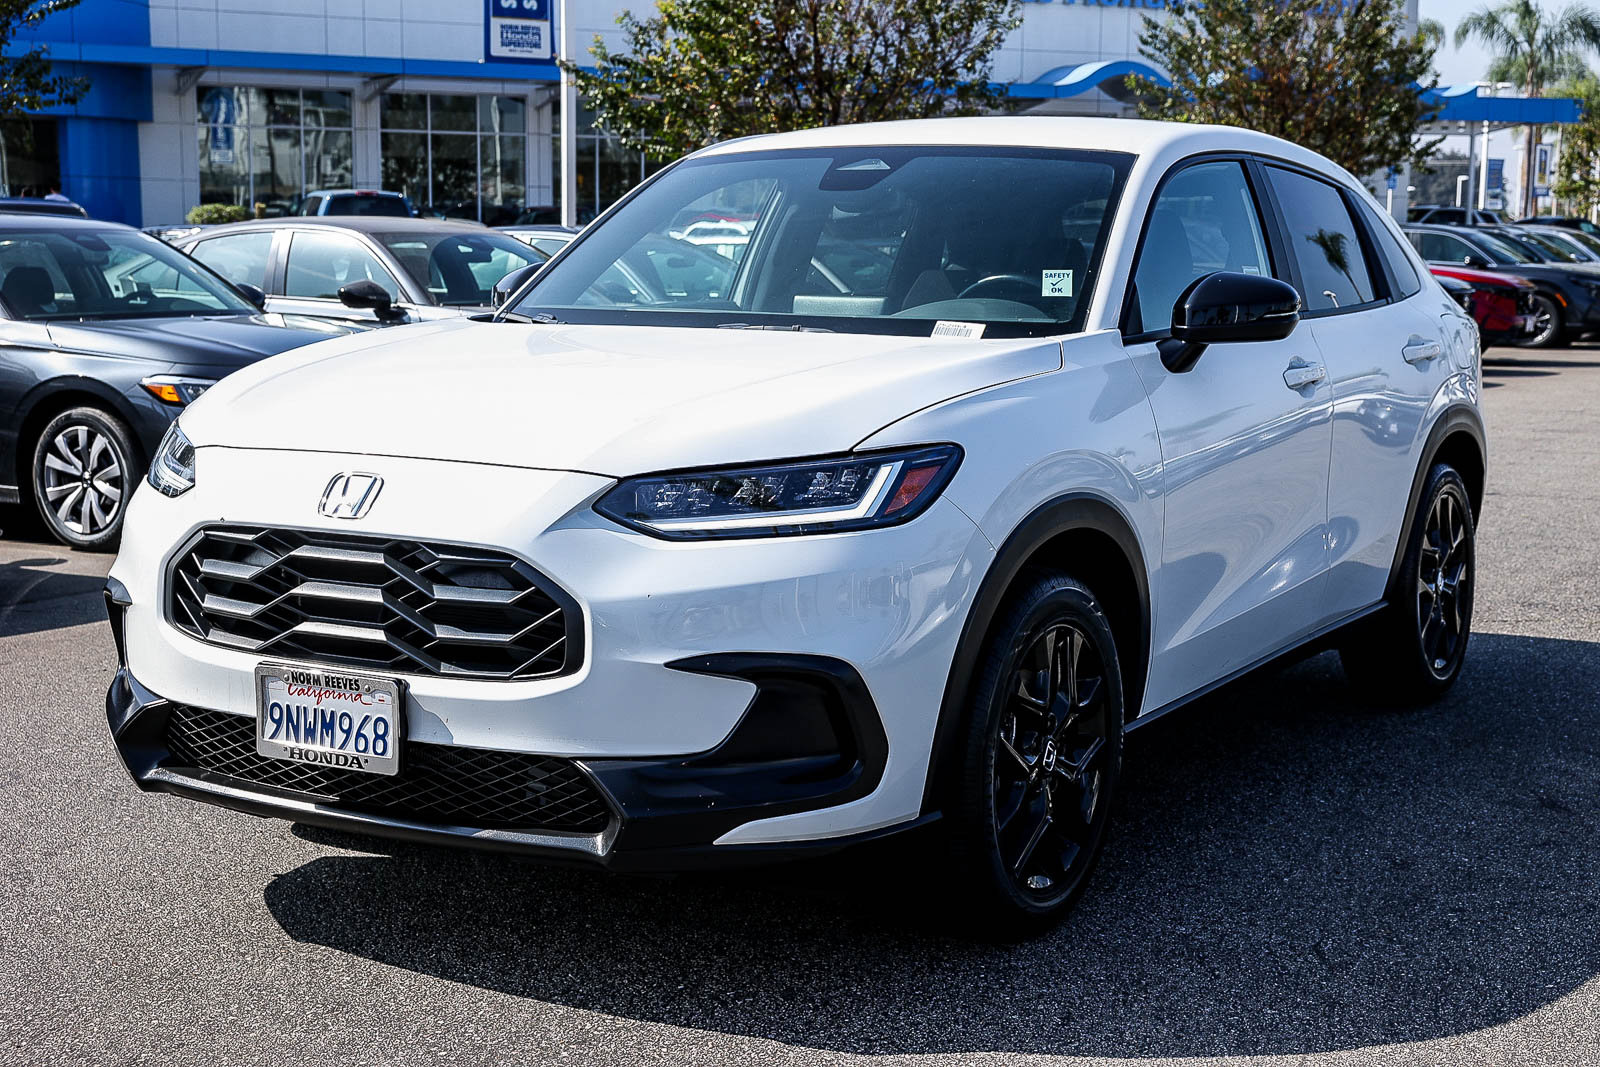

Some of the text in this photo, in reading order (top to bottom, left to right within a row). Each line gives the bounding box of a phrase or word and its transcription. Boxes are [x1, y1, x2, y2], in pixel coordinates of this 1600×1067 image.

[291, 671, 360, 691] NORM REEVES
[288, 683, 372, 705] California
[269, 702, 389, 756] 9NWM968
[289, 747, 365, 769] HONDA
